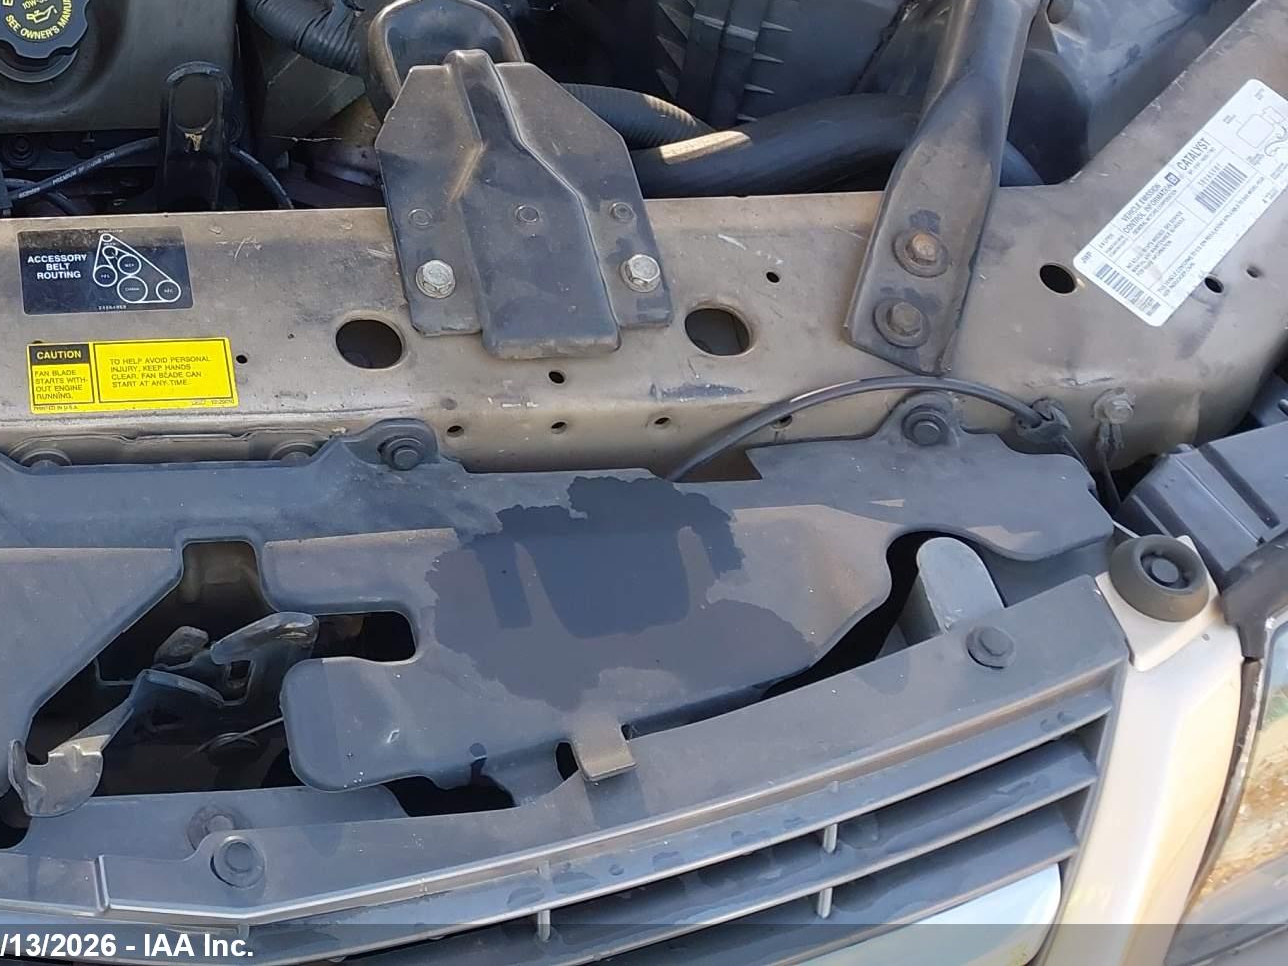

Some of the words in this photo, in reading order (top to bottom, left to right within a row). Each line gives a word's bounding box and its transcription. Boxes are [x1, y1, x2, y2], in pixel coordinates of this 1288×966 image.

[5, 14, 21, 32] SEE
[20, 25, 60, 40] OWNER'S
[1175, 137, 1210, 172] CATALYST
[28, 254, 87, 263] ACCESSORY
[46, 263, 69, 271] BELT
[37, 271, 81, 279] ROUTING
[36, 351, 81, 359] CAUTION
